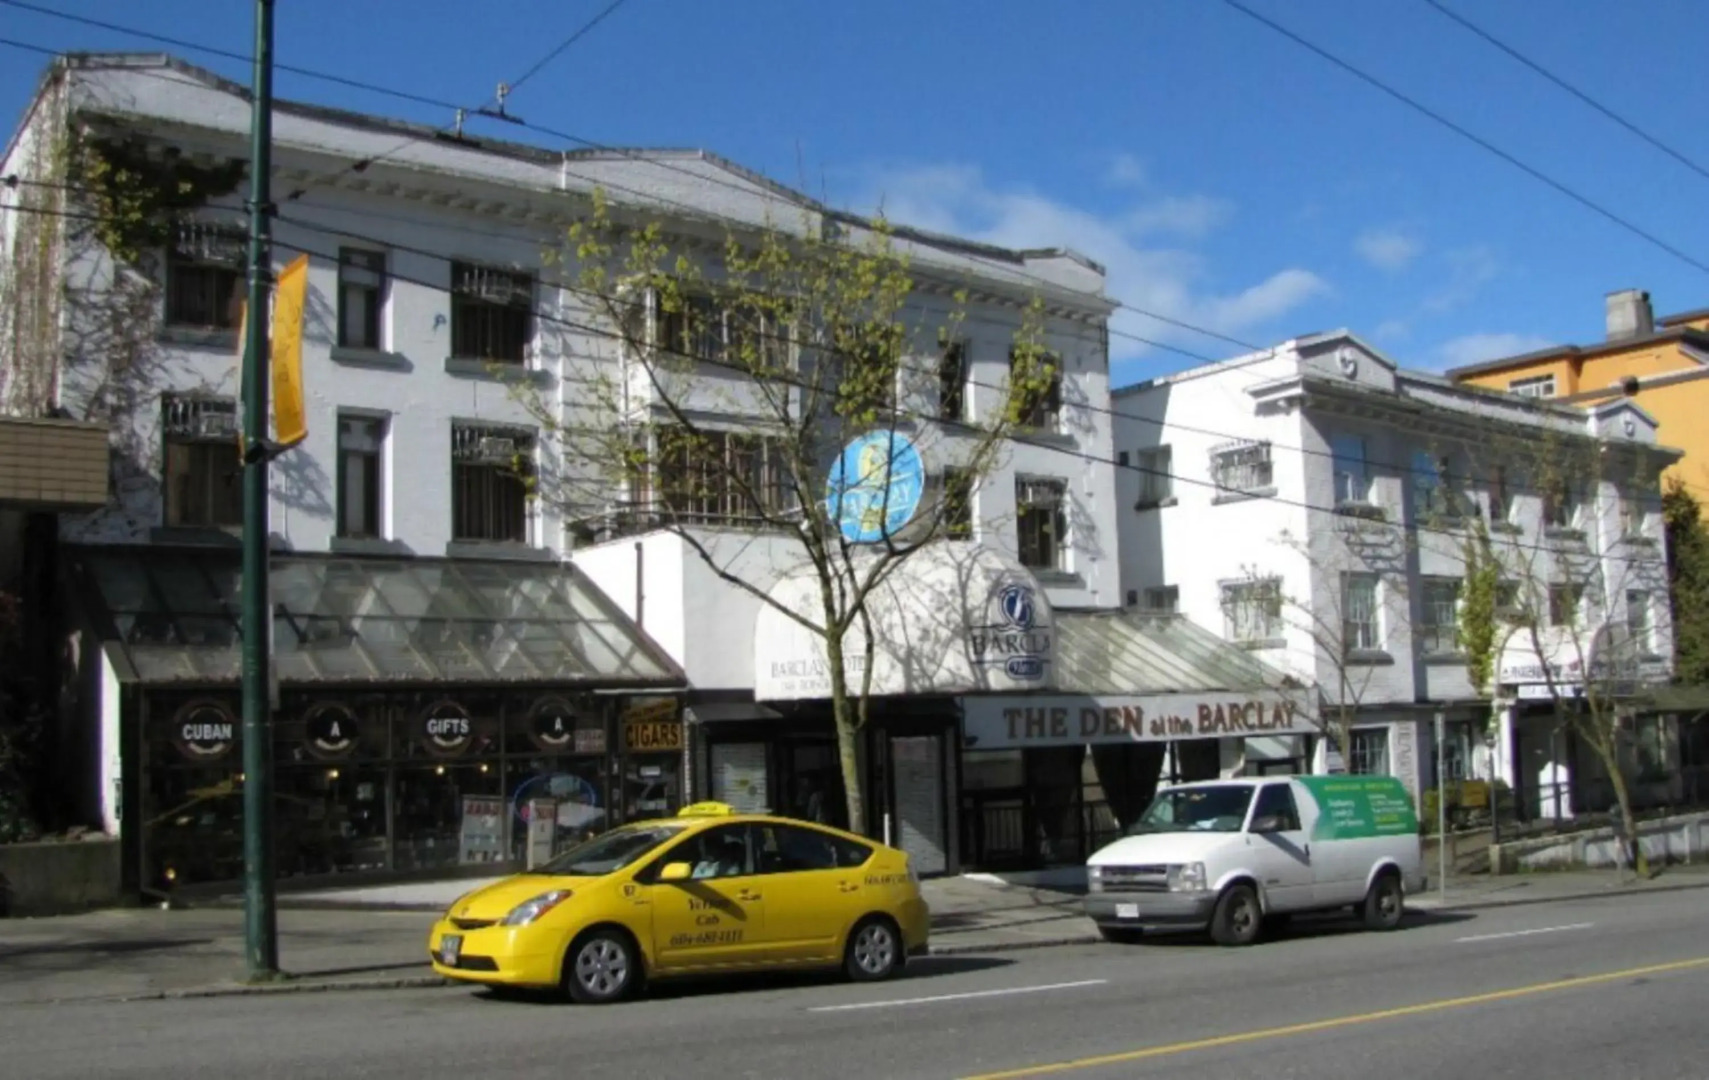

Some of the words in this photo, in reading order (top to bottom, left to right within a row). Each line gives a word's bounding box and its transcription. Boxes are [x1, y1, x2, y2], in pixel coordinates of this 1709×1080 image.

[427, 718, 469, 734] GIFTS
[1003, 707, 1069, 739] THE
[1080, 706, 1144, 736] DEN
[1168, 714, 1193, 735] the
[1197, 701, 1297, 733] BARCLAY
[183, 723, 232, 740] CUBAN
[625, 723, 679, 748] CIGARS
